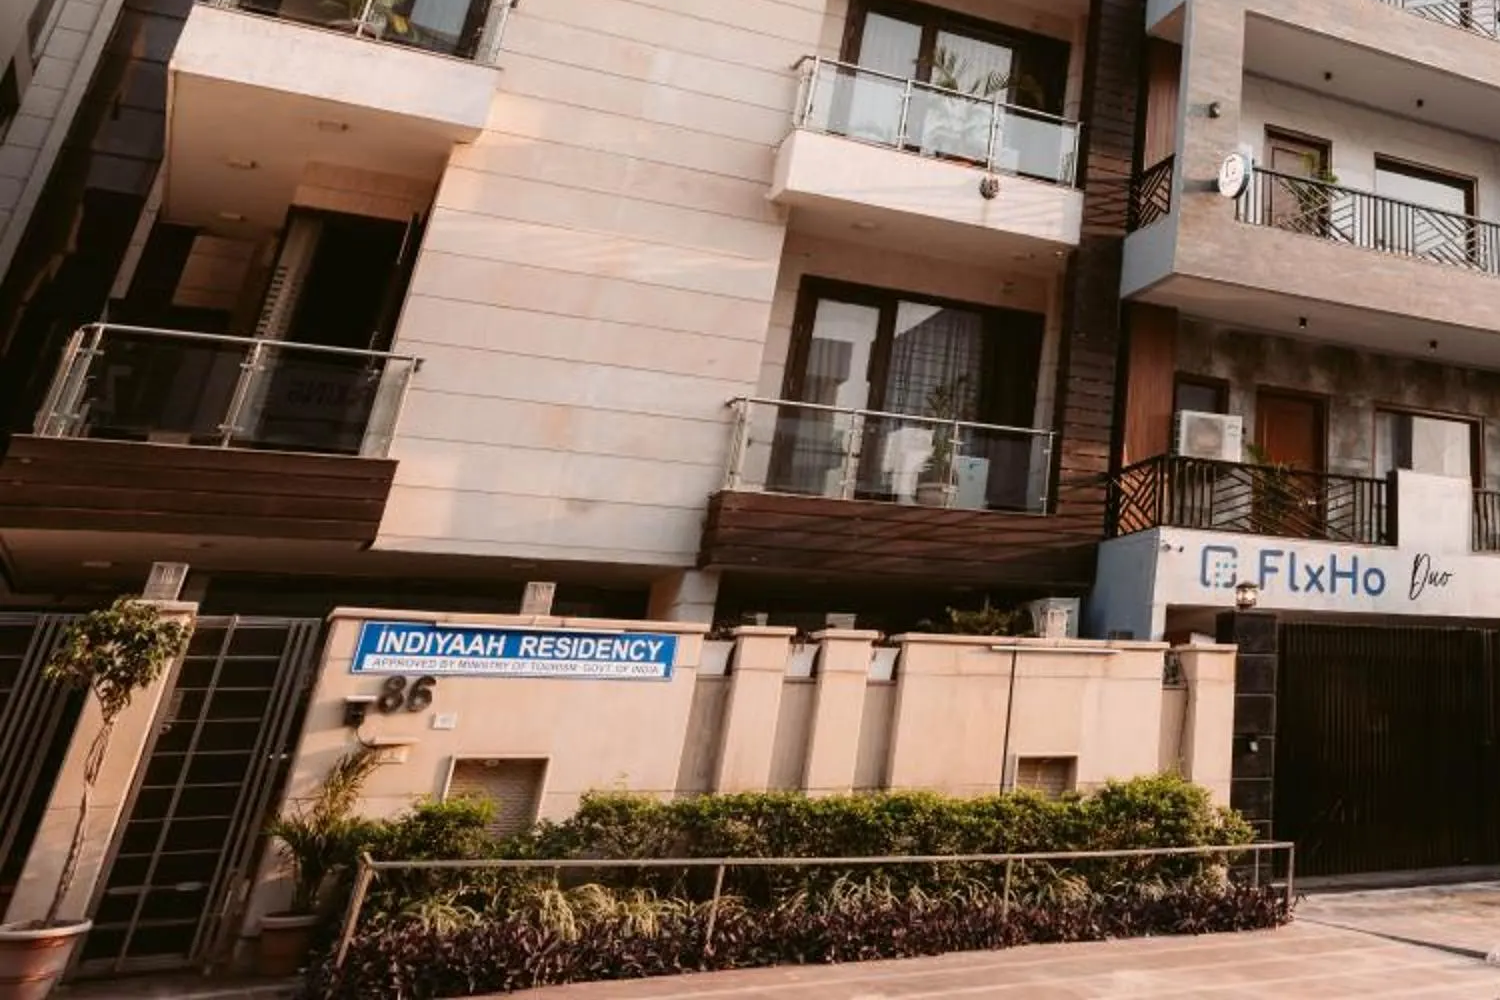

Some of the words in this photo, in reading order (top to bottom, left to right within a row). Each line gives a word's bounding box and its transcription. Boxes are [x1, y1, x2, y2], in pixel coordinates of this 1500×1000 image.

[1259, 549, 1386, 597] FlxHo
[1408, 553, 1453, 601] Duo
[375, 630, 507, 657] INDIYAAH
[518, 635, 664, 661] RESIDENCY
[378, 675, 437, 714] 86
